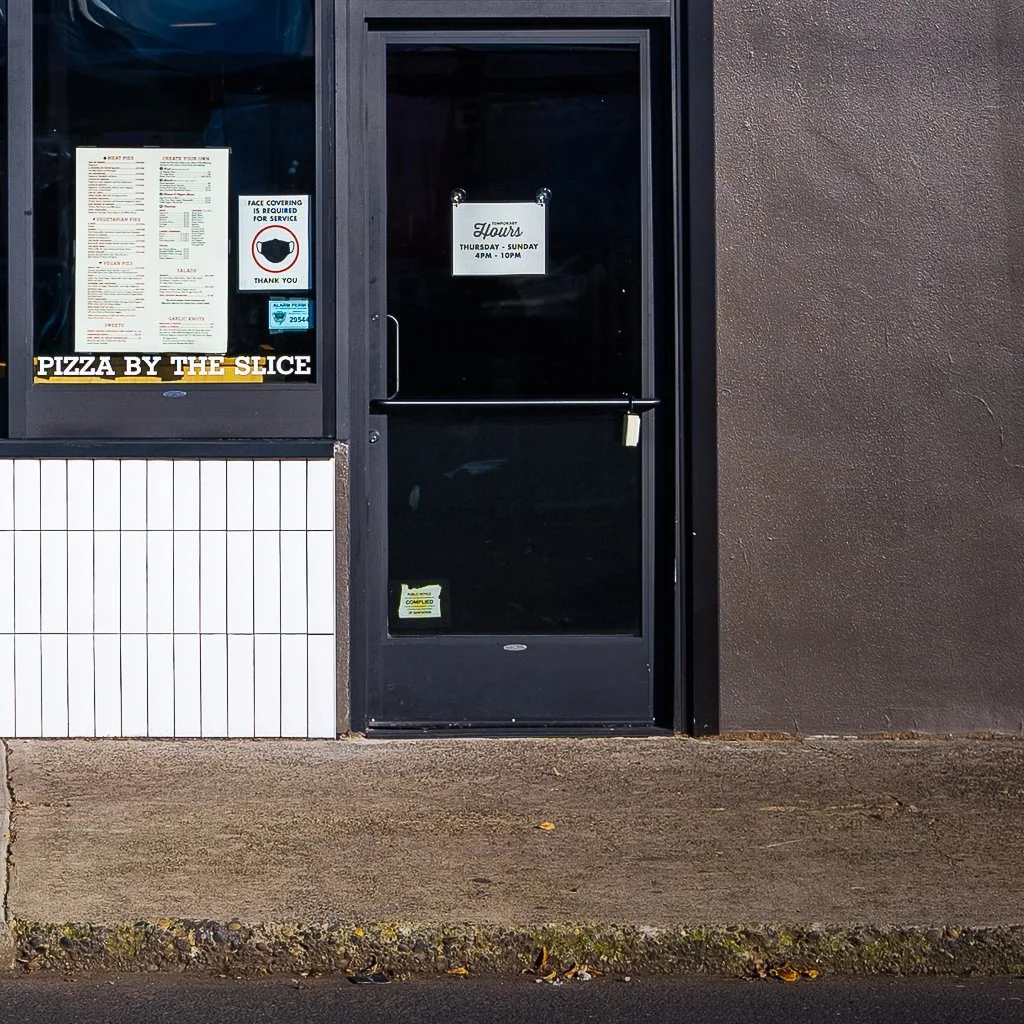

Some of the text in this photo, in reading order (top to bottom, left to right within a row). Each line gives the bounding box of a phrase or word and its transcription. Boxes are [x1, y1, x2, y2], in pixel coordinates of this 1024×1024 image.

[473, 222, 524, 240] Hours
[37, 356, 311, 376] PIZZA BY THE SLICE
